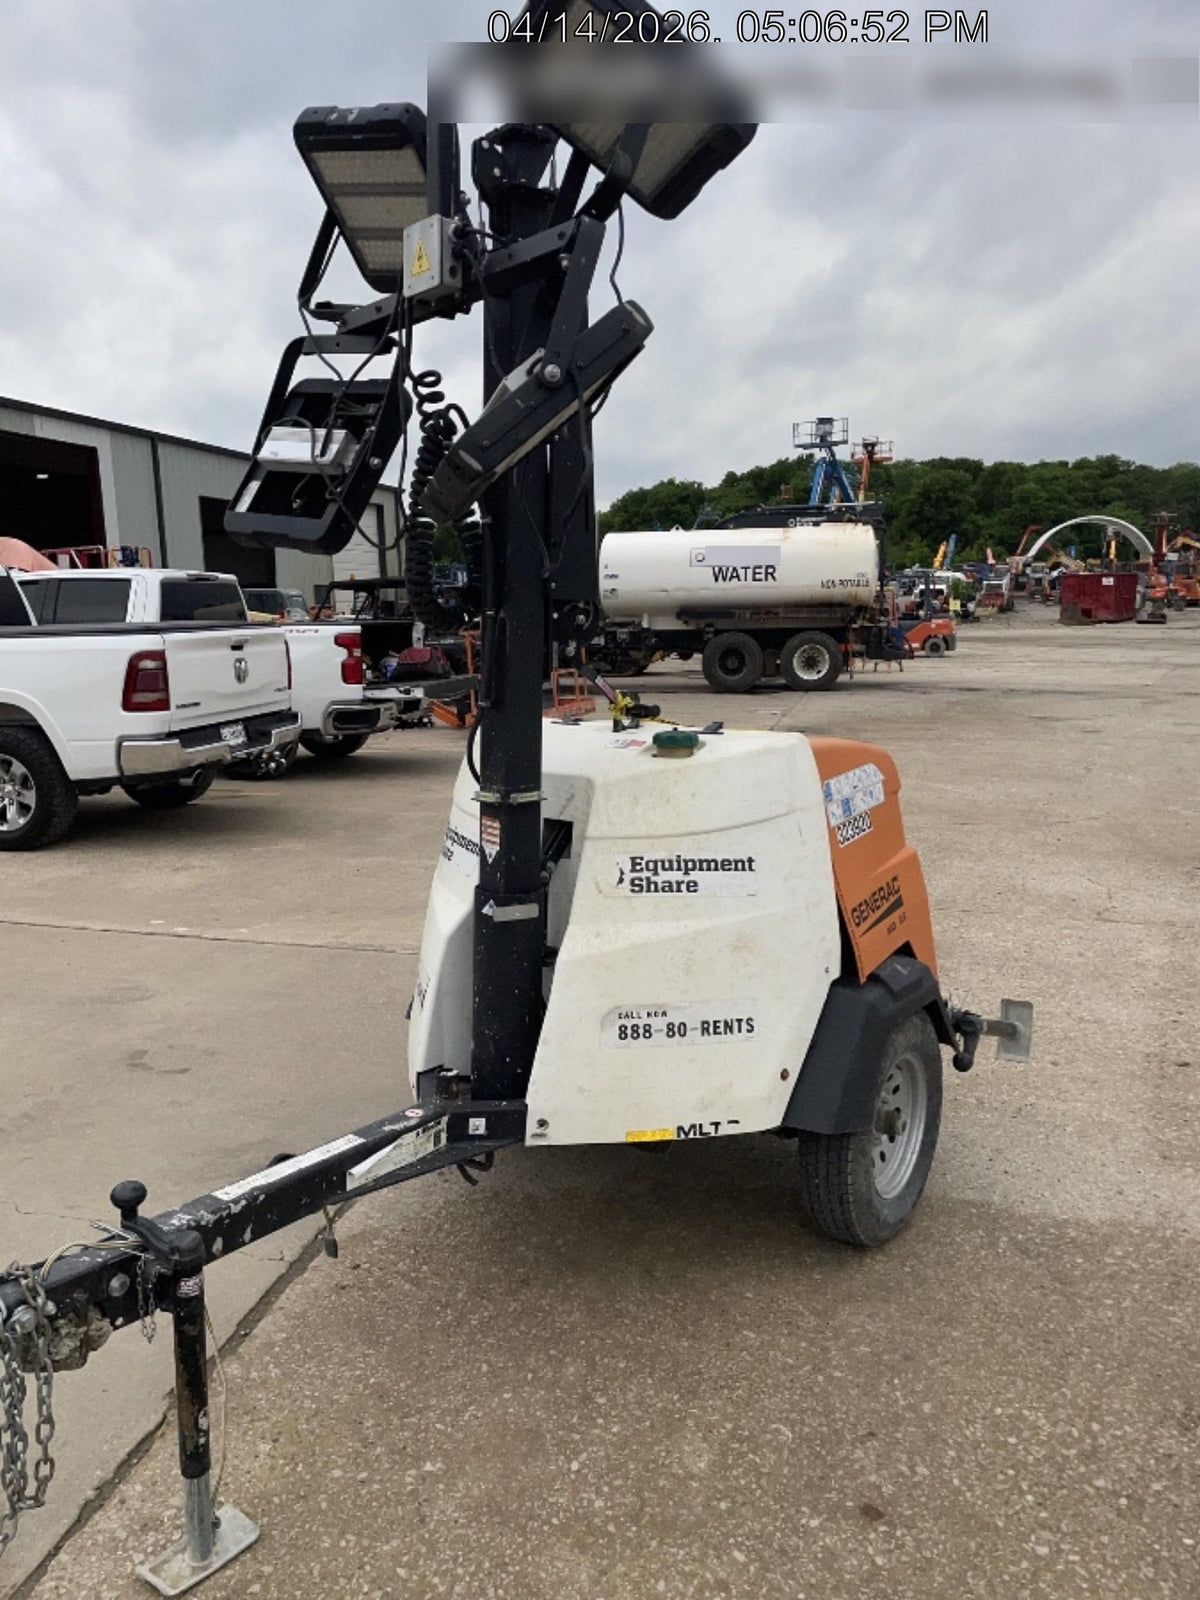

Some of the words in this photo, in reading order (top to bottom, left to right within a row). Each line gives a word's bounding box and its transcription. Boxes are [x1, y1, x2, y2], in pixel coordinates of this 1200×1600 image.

[712, 566, 777, 582] WATER
[630, 855, 756, 874] Equipment
[630, 876, 699, 894] Share
[851, 876, 901, 928] GENERAC
[618, 1017, 755, 1041] 888-80-RENTS
